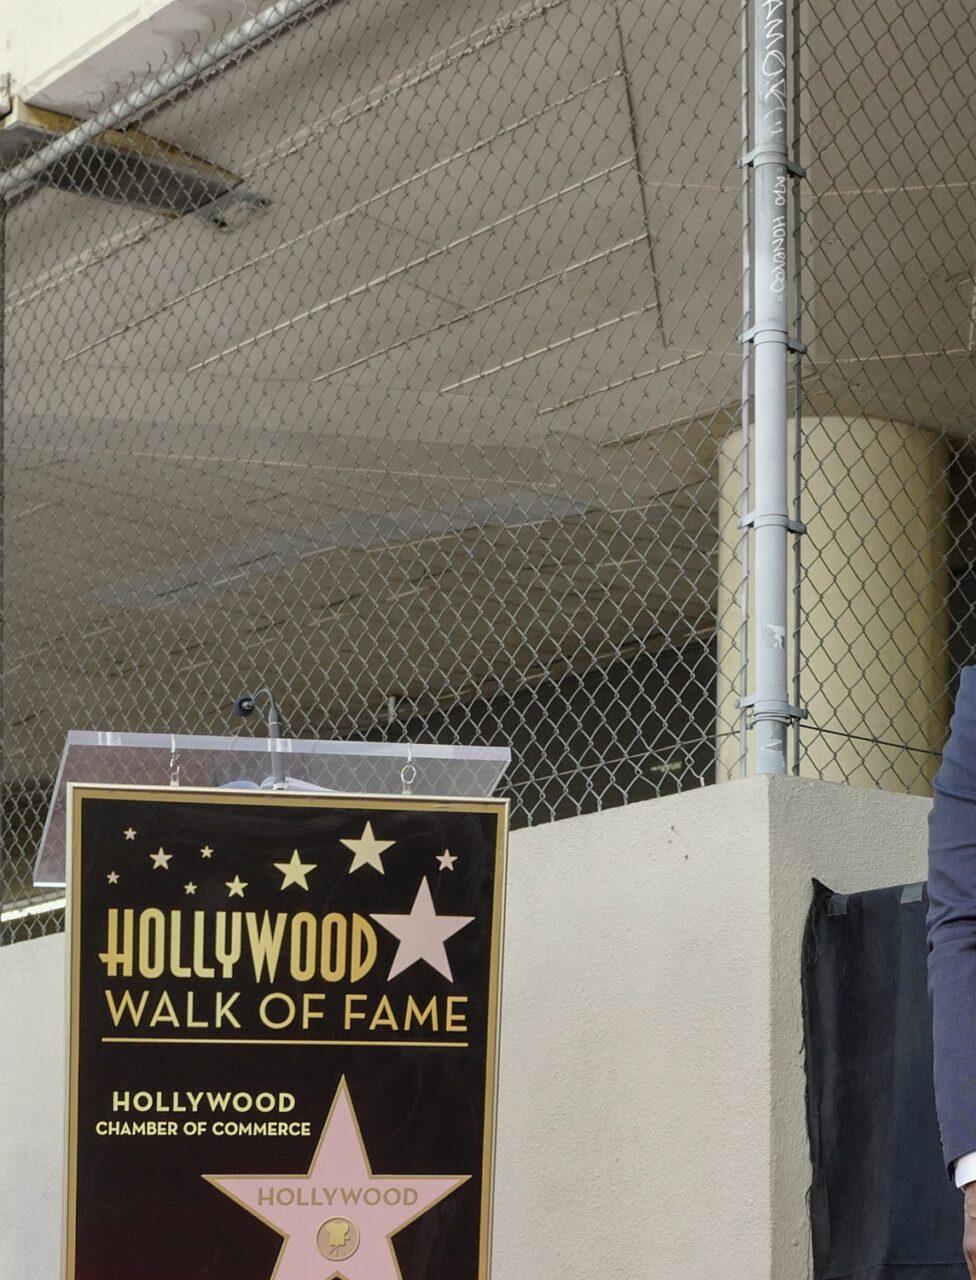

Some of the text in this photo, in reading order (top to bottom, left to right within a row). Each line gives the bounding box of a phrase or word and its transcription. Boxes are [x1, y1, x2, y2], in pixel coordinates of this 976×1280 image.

[98, 907, 378, 984] HOLLYWOOD
[104, 989, 469, 1033] WALK OF FAME
[112, 1091, 296, 1113] HOLLYWOOD
[95, 1121, 311, 1137] CHAMBER OF COMMERCE
[257, 1187, 419, 1207] HOLLYWOOD
